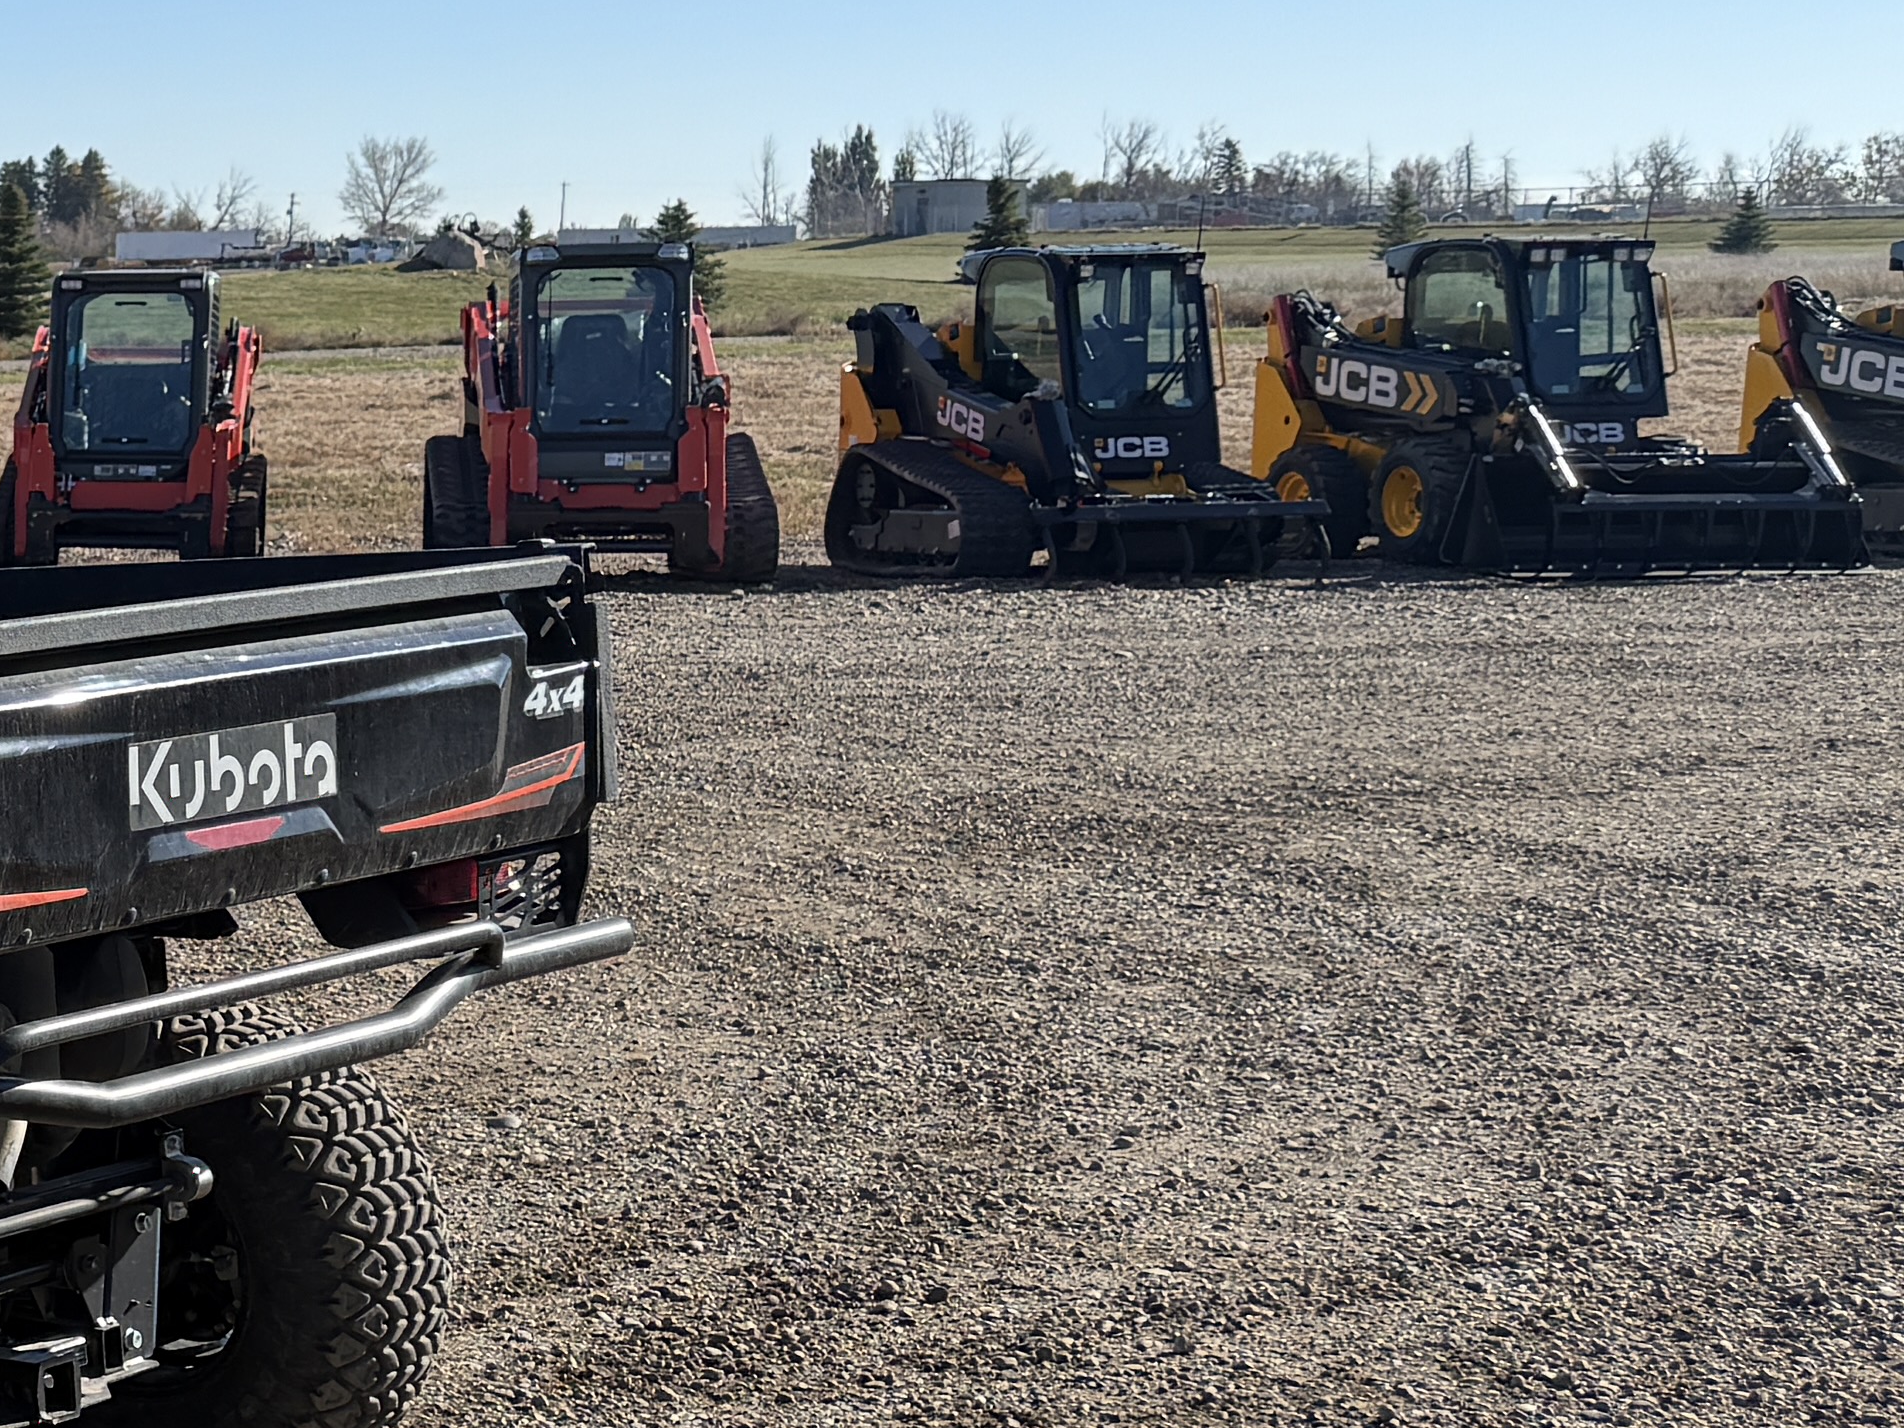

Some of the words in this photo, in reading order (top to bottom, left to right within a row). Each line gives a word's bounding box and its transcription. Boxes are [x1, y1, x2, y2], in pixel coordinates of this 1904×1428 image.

[1314, 356, 1399, 408] JCB
[936, 398, 985, 443] JCB
[1095, 436, 1169, 459] JCB
[523, 674, 585, 719] 4x4
[128, 722, 337, 823] Kubota
